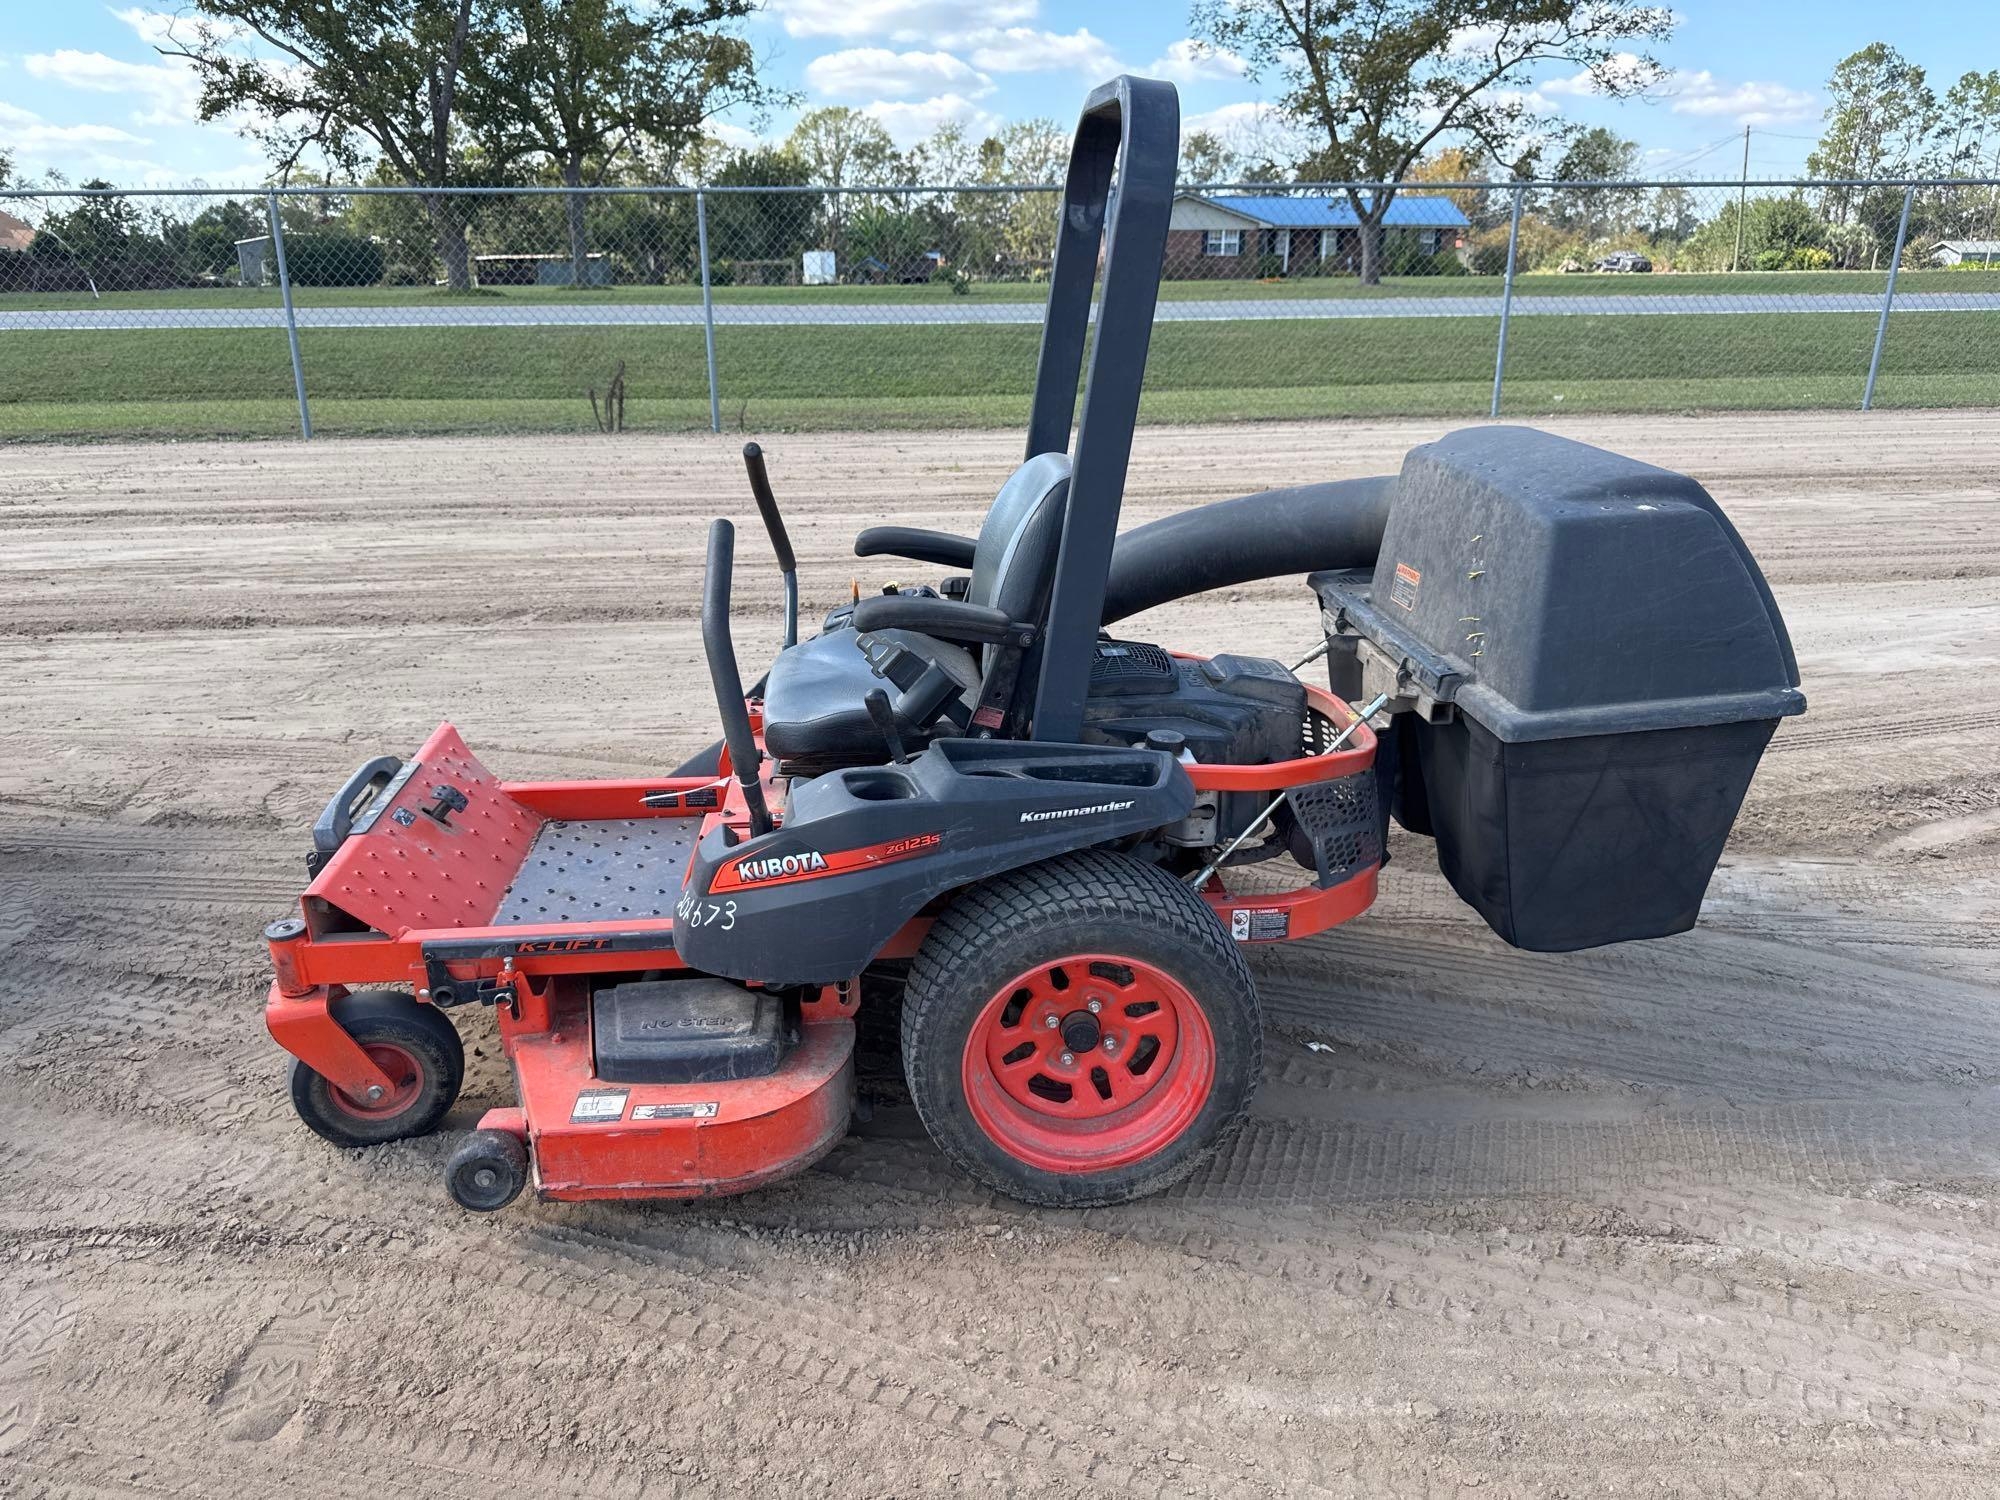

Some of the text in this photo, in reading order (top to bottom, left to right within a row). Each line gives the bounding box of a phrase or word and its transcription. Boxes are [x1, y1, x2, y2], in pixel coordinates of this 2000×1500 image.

[1020, 800, 1135, 822] Kommander
[738, 851, 828, 882] KUBOTA
[517, 939, 610, 952] K-LIFT
[641, 1017, 734, 1030] NO STEP
